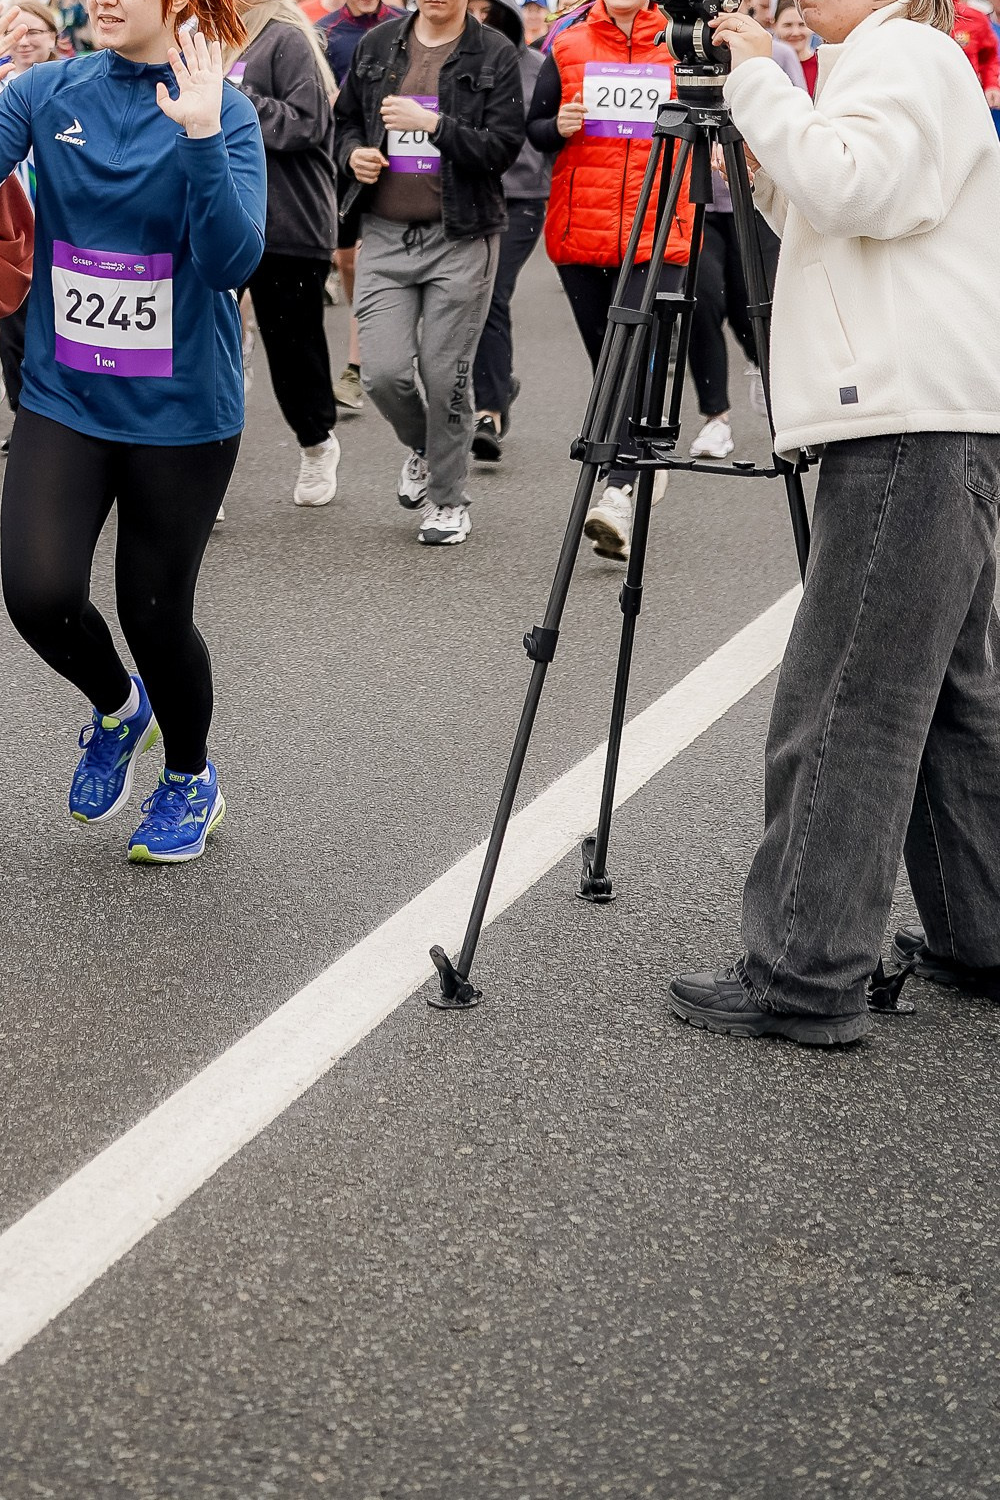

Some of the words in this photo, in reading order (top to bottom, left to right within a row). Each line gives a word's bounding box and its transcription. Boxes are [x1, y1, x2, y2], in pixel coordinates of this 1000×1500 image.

[595, 86, 660, 111] 2029
[54, 133, 87, 147] DEMIX
[65, 288, 157, 332] 2245
[447, 360, 470, 425] BRAVE
